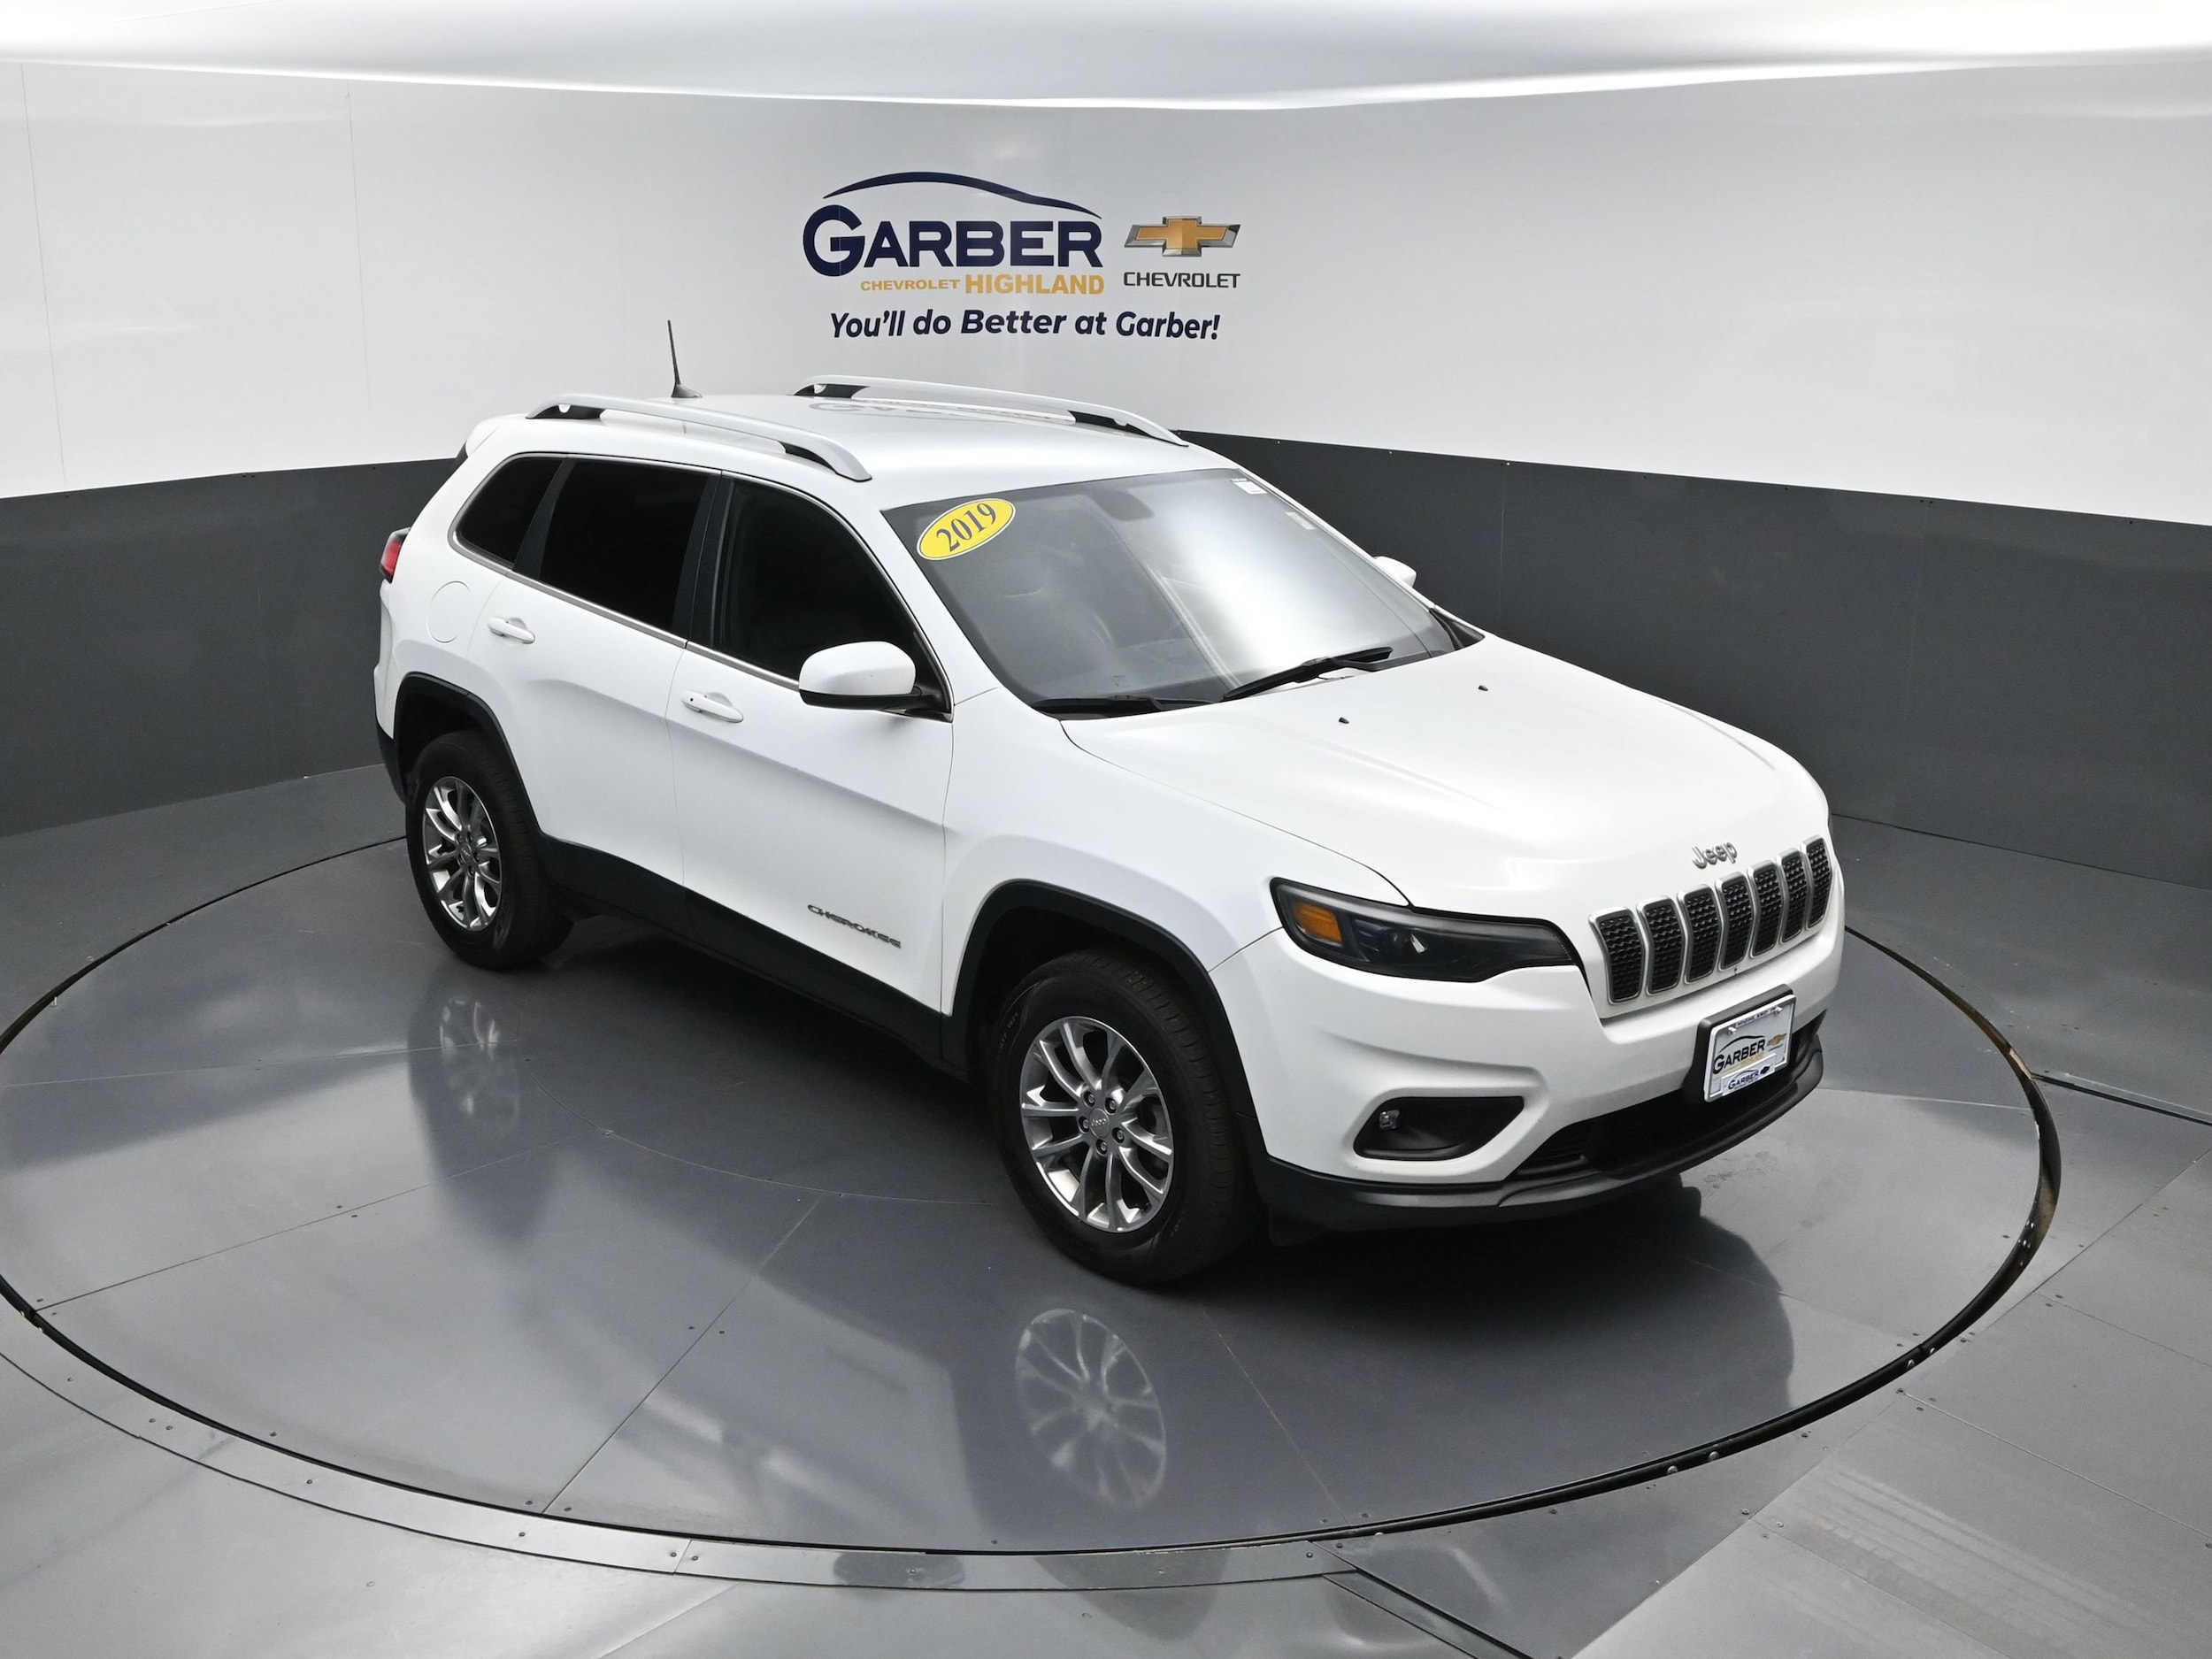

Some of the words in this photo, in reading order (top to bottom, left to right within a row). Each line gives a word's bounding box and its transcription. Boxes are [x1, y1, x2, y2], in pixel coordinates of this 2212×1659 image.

[803, 204, 1103, 276] GARBER
[860, 279, 961, 291] CHEVROLET
[964, 273, 1105, 295] HIGHLAND
[1123, 271, 1241, 288] CHEVROLET
[912, 309, 951, 335] do
[961, 309, 1067, 335] Better
[1074, 314, 1107, 336] at
[1116, 311, 1221, 340] Garber!
[936, 503, 996, 552] 2019
[1691, 842, 1738, 869] Jeep
[807, 904, 902, 949] CHEROKEE
[1713, 1039, 1766, 1074] GARBER
[1728, 1071, 1759, 1090] GARBER
